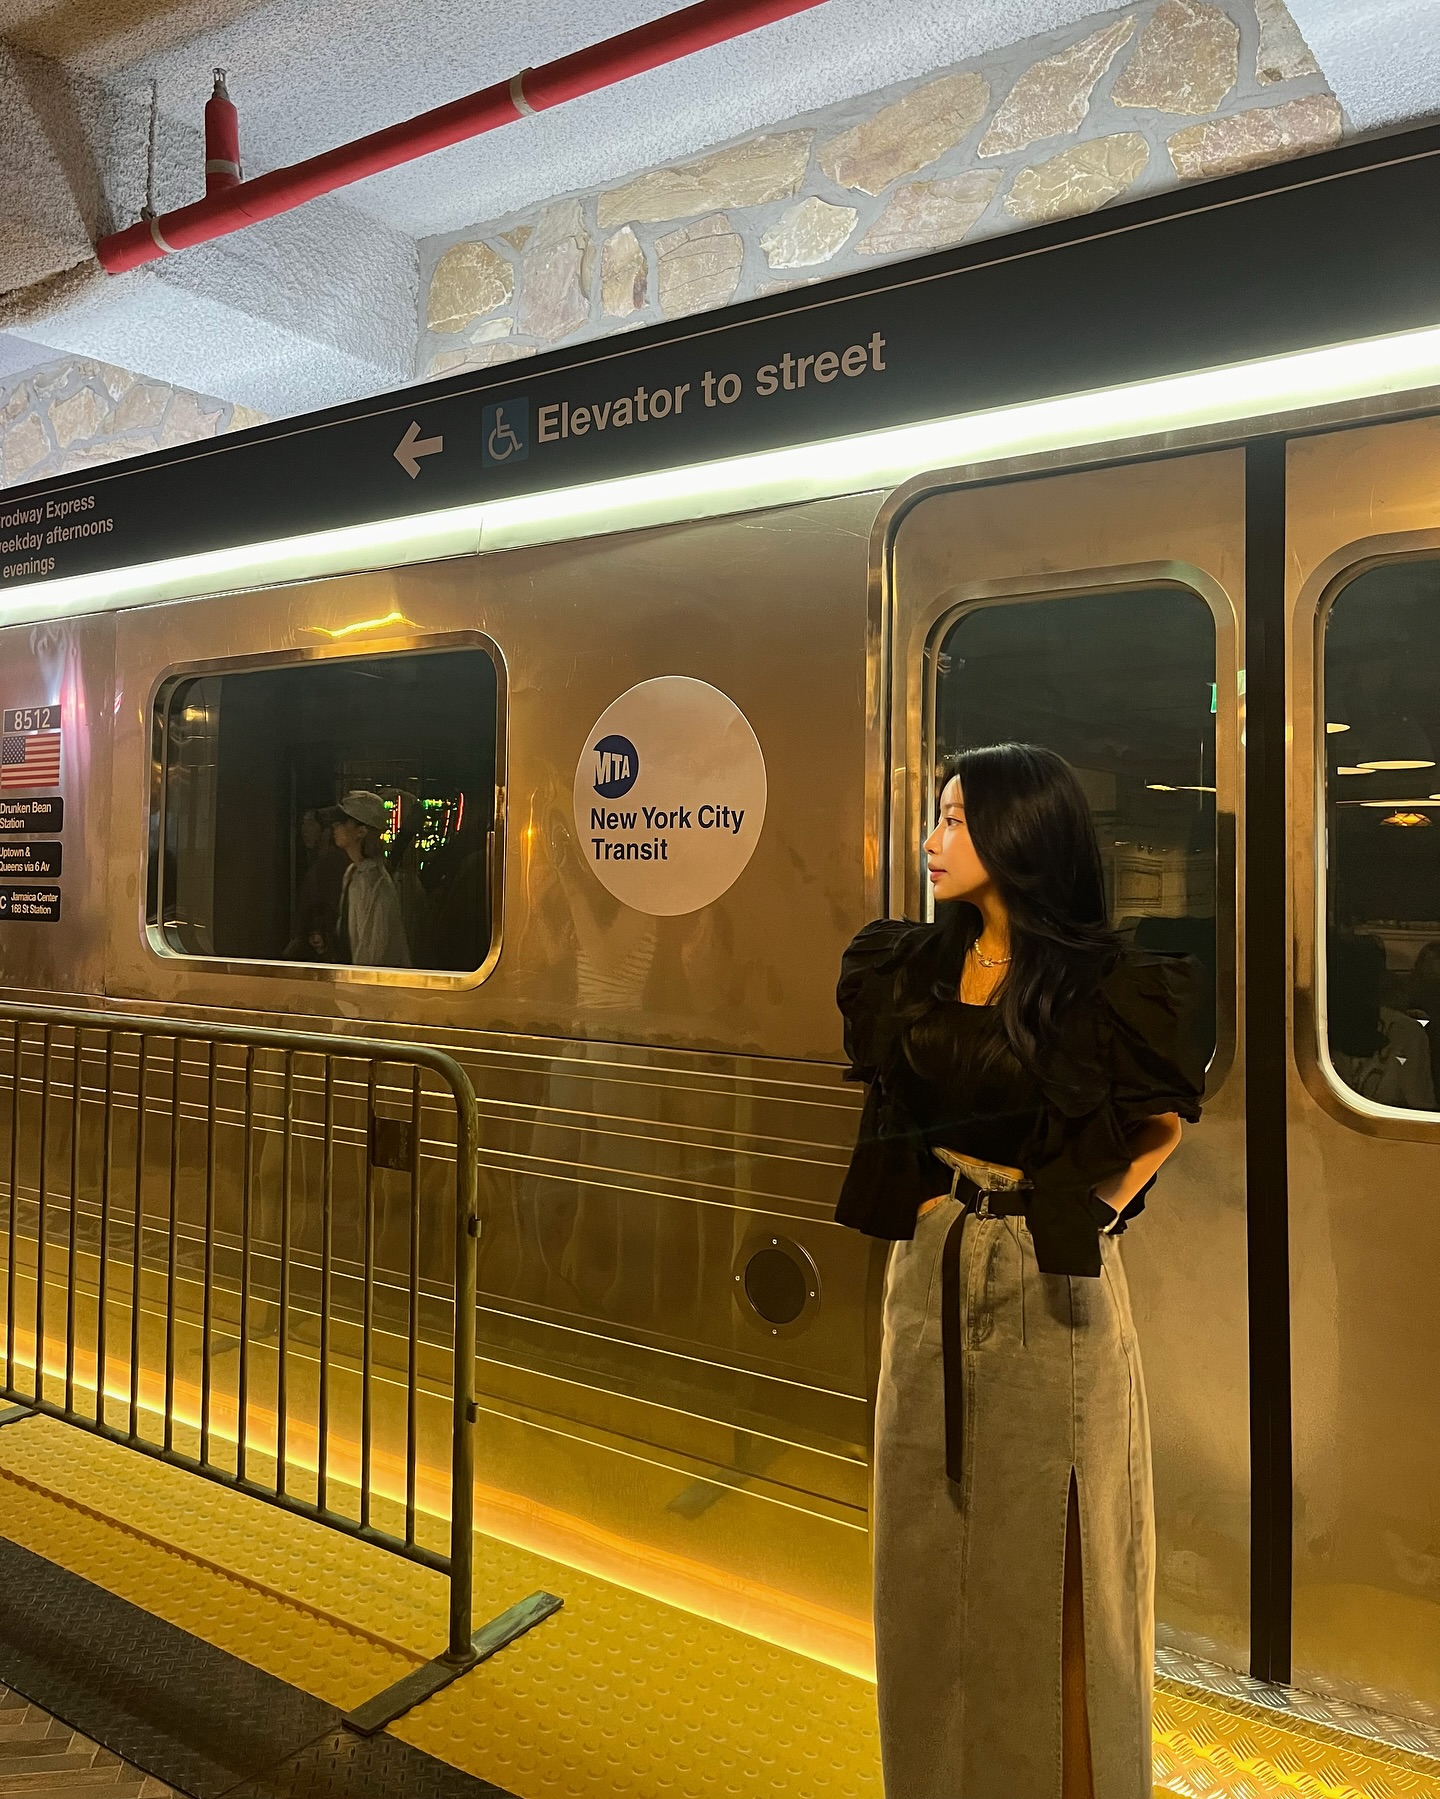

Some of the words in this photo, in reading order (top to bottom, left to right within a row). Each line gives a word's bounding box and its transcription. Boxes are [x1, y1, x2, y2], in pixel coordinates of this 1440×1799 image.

[538, 383, 690, 443] Elevator
[701, 371, 742, 407] to
[755, 331, 887, 396] street
[0, 508, 43, 529] rodway
[46, 495, 95, 519] Express
[46, 518, 114, 545] afternoons
[3, 556, 55, 579] evenings
[14, 707, 51, 731] 8512
[593, 750, 630, 786] MTA
[0, 802, 31, 814] Drunken
[32, 801, 52, 813] Bean
[0, 817, 25, 829] Station
[590, 807, 638, 830] New
[642, 806, 692, 829] York
[697, 804, 745, 835] City
[25, 846, 31, 857] &
[591, 837, 668, 861] Transit
[24, 861, 35, 872] via
[34, 861, 40, 872] 6
[40, 861, 50, 872] Av
[11, 891, 37, 902] Jamaica
[37, 892, 59, 903] Center
[22, 903, 30, 914] St
[30, 904, 52, 915] Station
